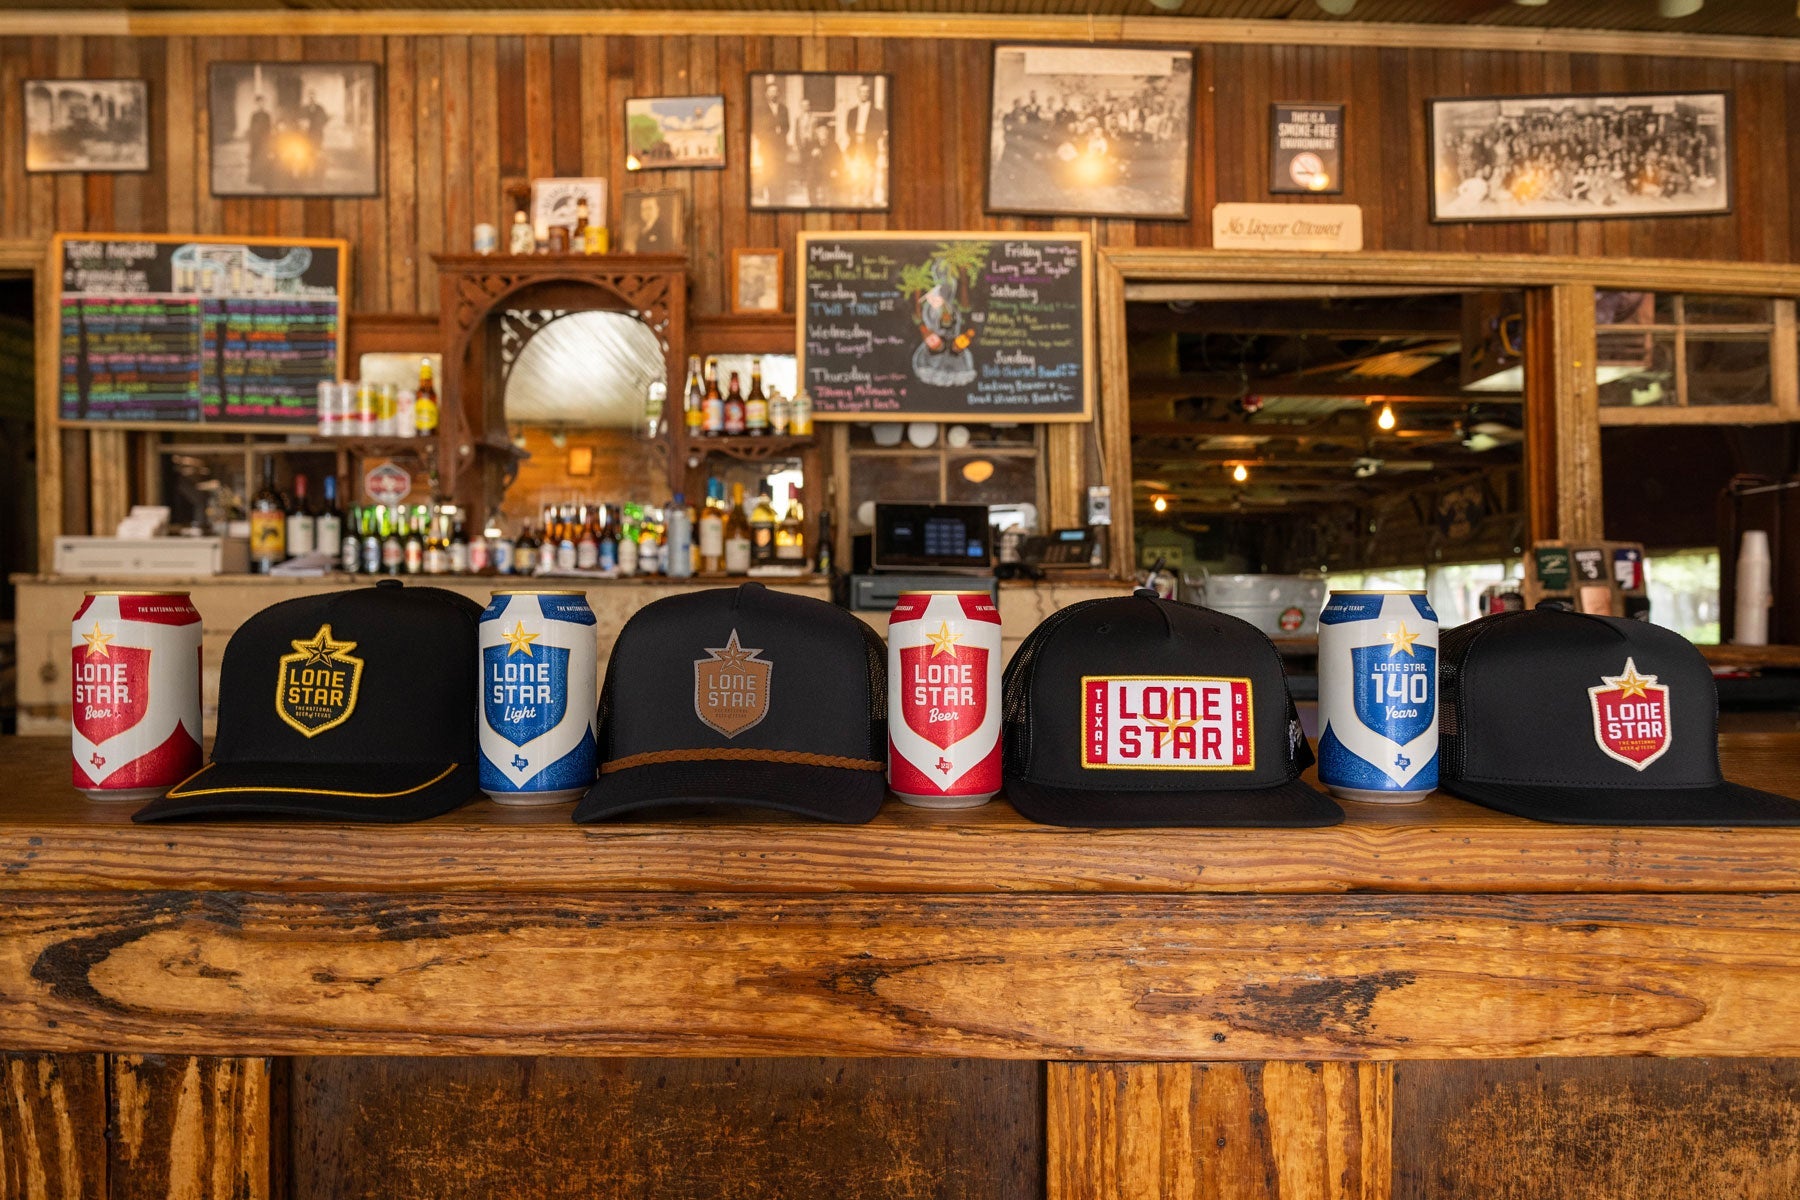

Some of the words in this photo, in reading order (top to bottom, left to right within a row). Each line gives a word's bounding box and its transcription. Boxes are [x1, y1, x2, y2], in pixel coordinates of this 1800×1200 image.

[1278, 124, 1337, 138] SMOKE-FREE
[1280, 138, 1335, 150] ENVIRONMENT
[810, 244, 853, 268] Monday
[1005, 242, 1042, 267] Friday
[809, 283, 857, 305] Tuesday
[990, 284, 1039, 304] Saturday
[808, 323, 872, 352] Wednesday
[994, 349, 1036, 370] Sunday
[809, 365, 872, 388] Thursday
[76, 663, 127, 683] LONE
[493, 663, 550, 682] LONE
[914, 664, 973, 684] LONE
[1374, 663, 1402, 672] LONE
[290, 668, 346, 688] LONE
[708, 674, 757, 690] LONE
[288, 687, 344, 707] STAR
[1371, 673, 1428, 704] 140
[708, 691, 756, 708] STAR
[1119, 686, 1221, 721] LONE
[85, 705, 112, 720] Beer
[504, 705, 537, 724] Light
[929, 707, 959, 724] Beer
[1094, 688, 1103, 756] TEXAS
[1385, 705, 1418, 721] Years
[1606, 703, 1661, 721] LONE
[1235, 693, 1244, 756] BEER
[1608, 722, 1663, 740] STAR
[1119, 725, 1223, 760] STAR
